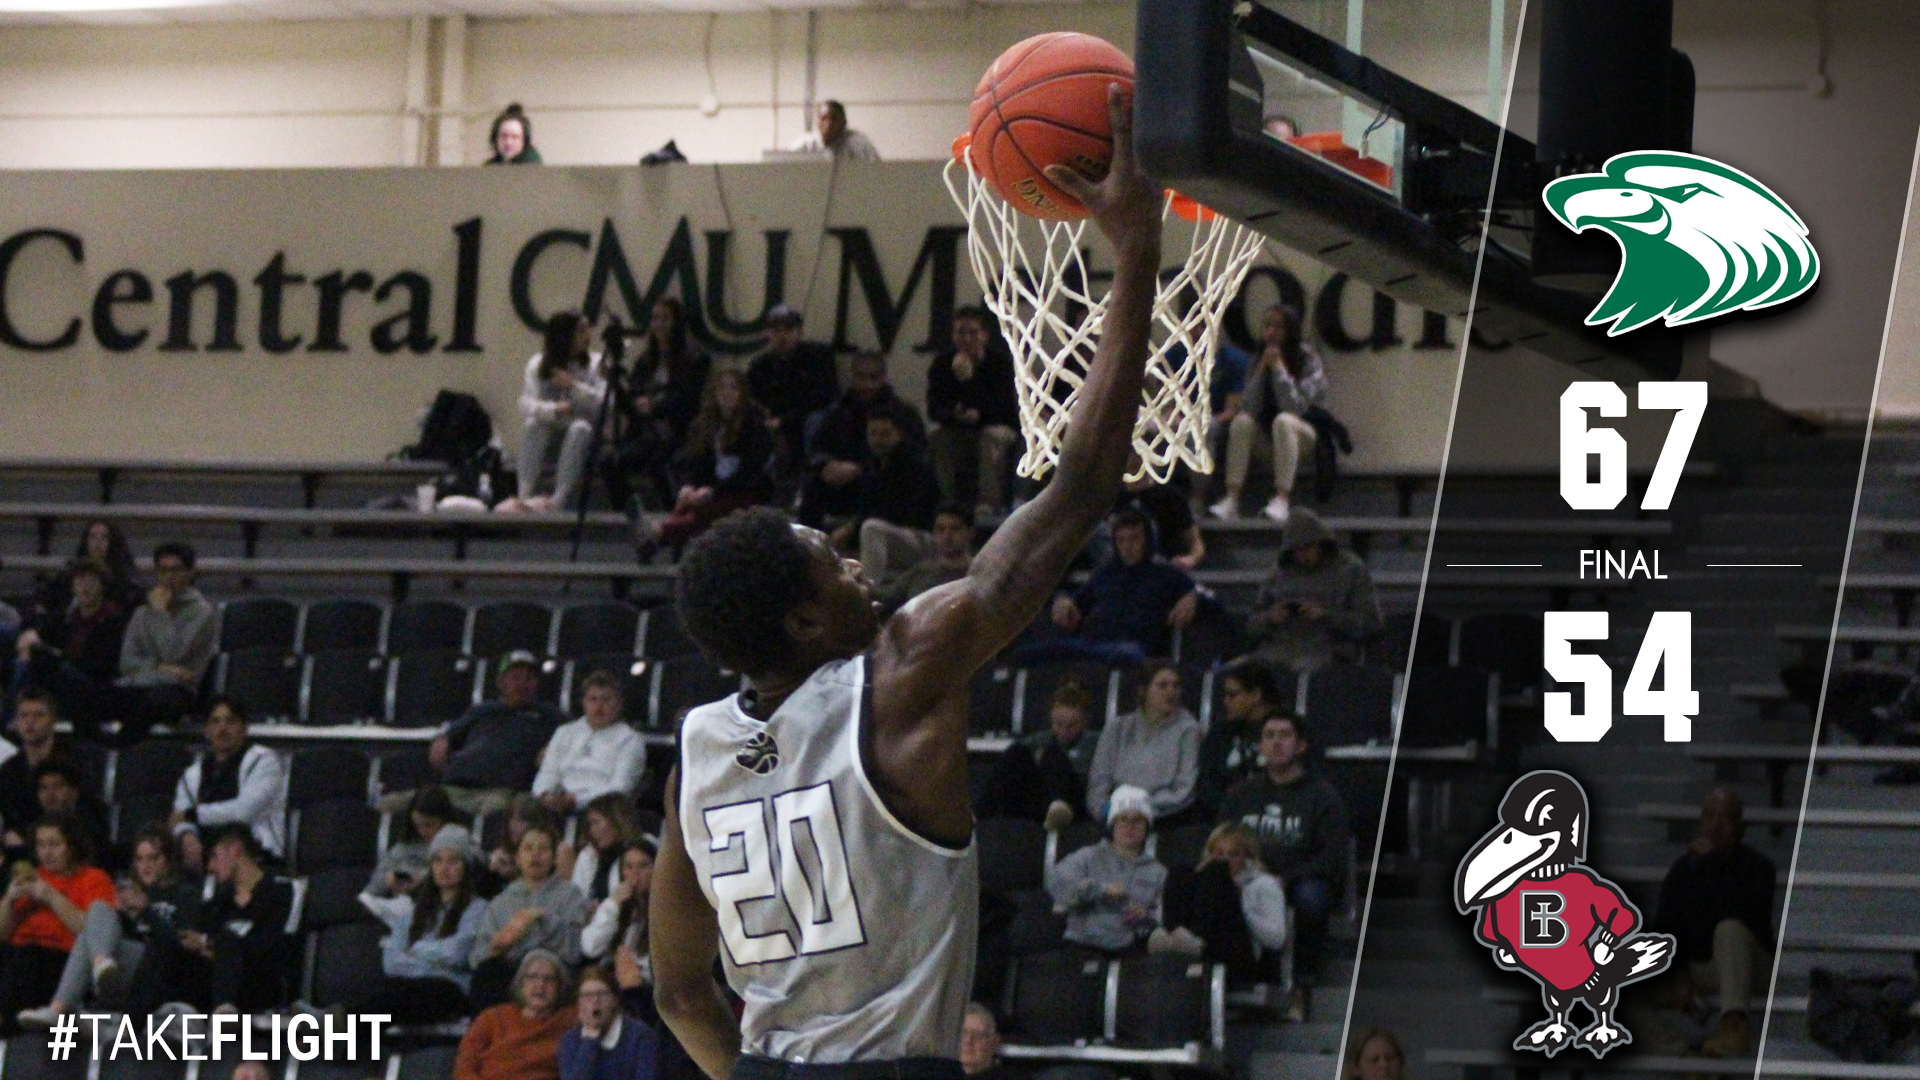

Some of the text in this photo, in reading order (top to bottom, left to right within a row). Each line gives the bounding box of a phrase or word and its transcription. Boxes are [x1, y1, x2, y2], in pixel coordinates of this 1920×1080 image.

[0, 216, 485, 353] Central
[509, 214, 794, 355] CMU
[702, 779, 867, 967] 20
